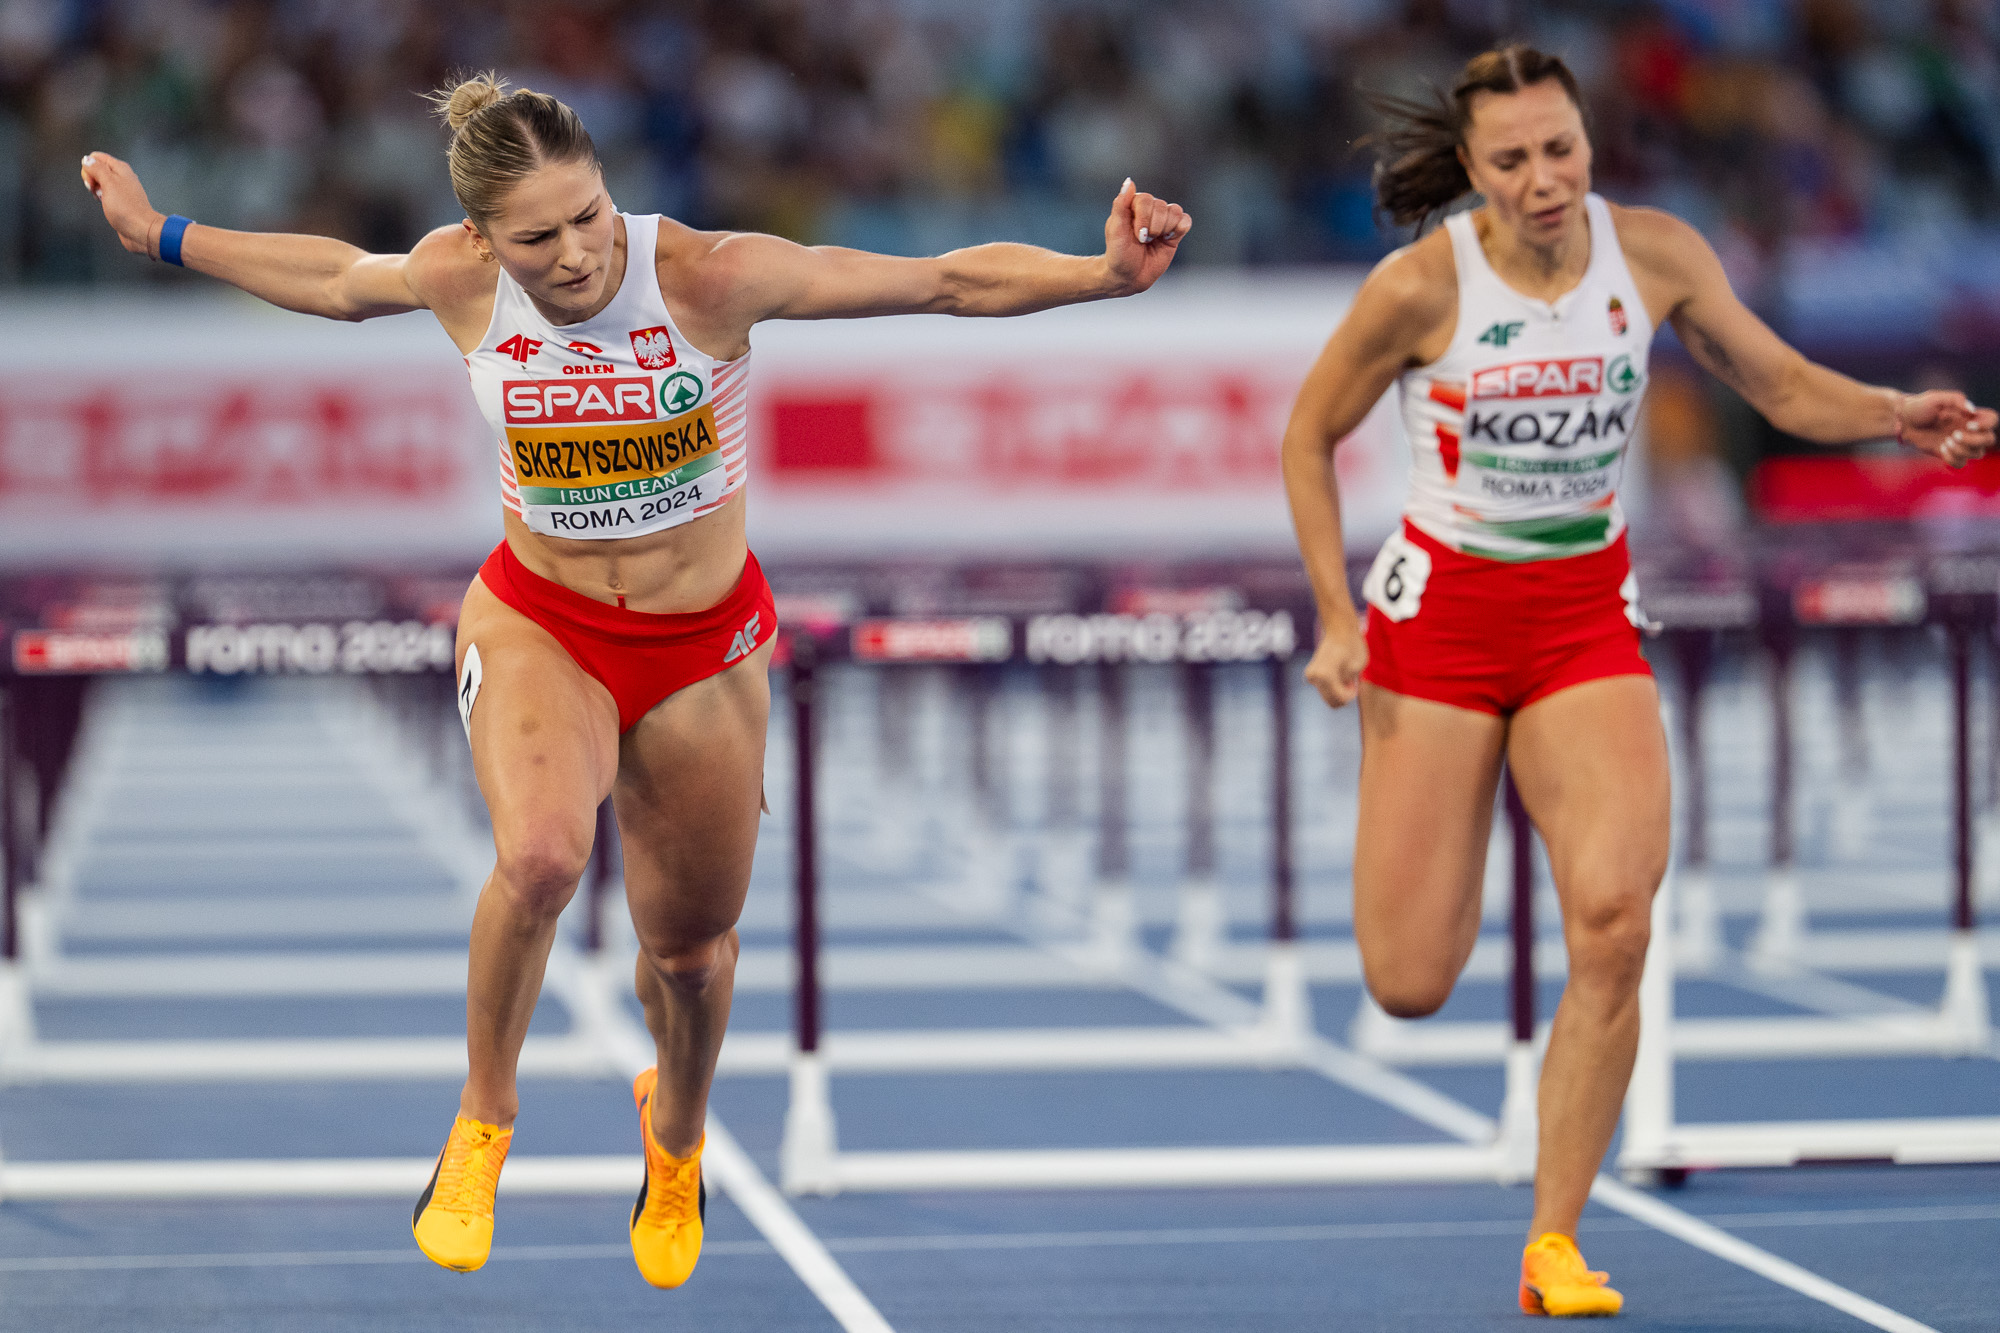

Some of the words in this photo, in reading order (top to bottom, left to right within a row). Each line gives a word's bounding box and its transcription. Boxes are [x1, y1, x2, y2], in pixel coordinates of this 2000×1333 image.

[496, 333, 543, 363] 4F
[1477, 321, 1525, 348] 4F
[562, 364, 615, 375] ORLEN
[1476, 361, 1599, 396] SPAR
[507, 383, 652, 418] SPAR
[1470, 397, 1633, 448] KOZÁK
[515, 417, 713, 479] SKRZYSZOWSKA
[560, 490, 565, 503] I
[570, 487, 612, 503] RUN
[1482, 475, 1553, 497] ROMA
[1560, 472, 1608, 497] 2024
[551, 507, 635, 530] ROMA
[640, 485, 703, 521] 2024
[1385, 557, 1406, 602] 6
[723, 611, 761, 663] 4F
